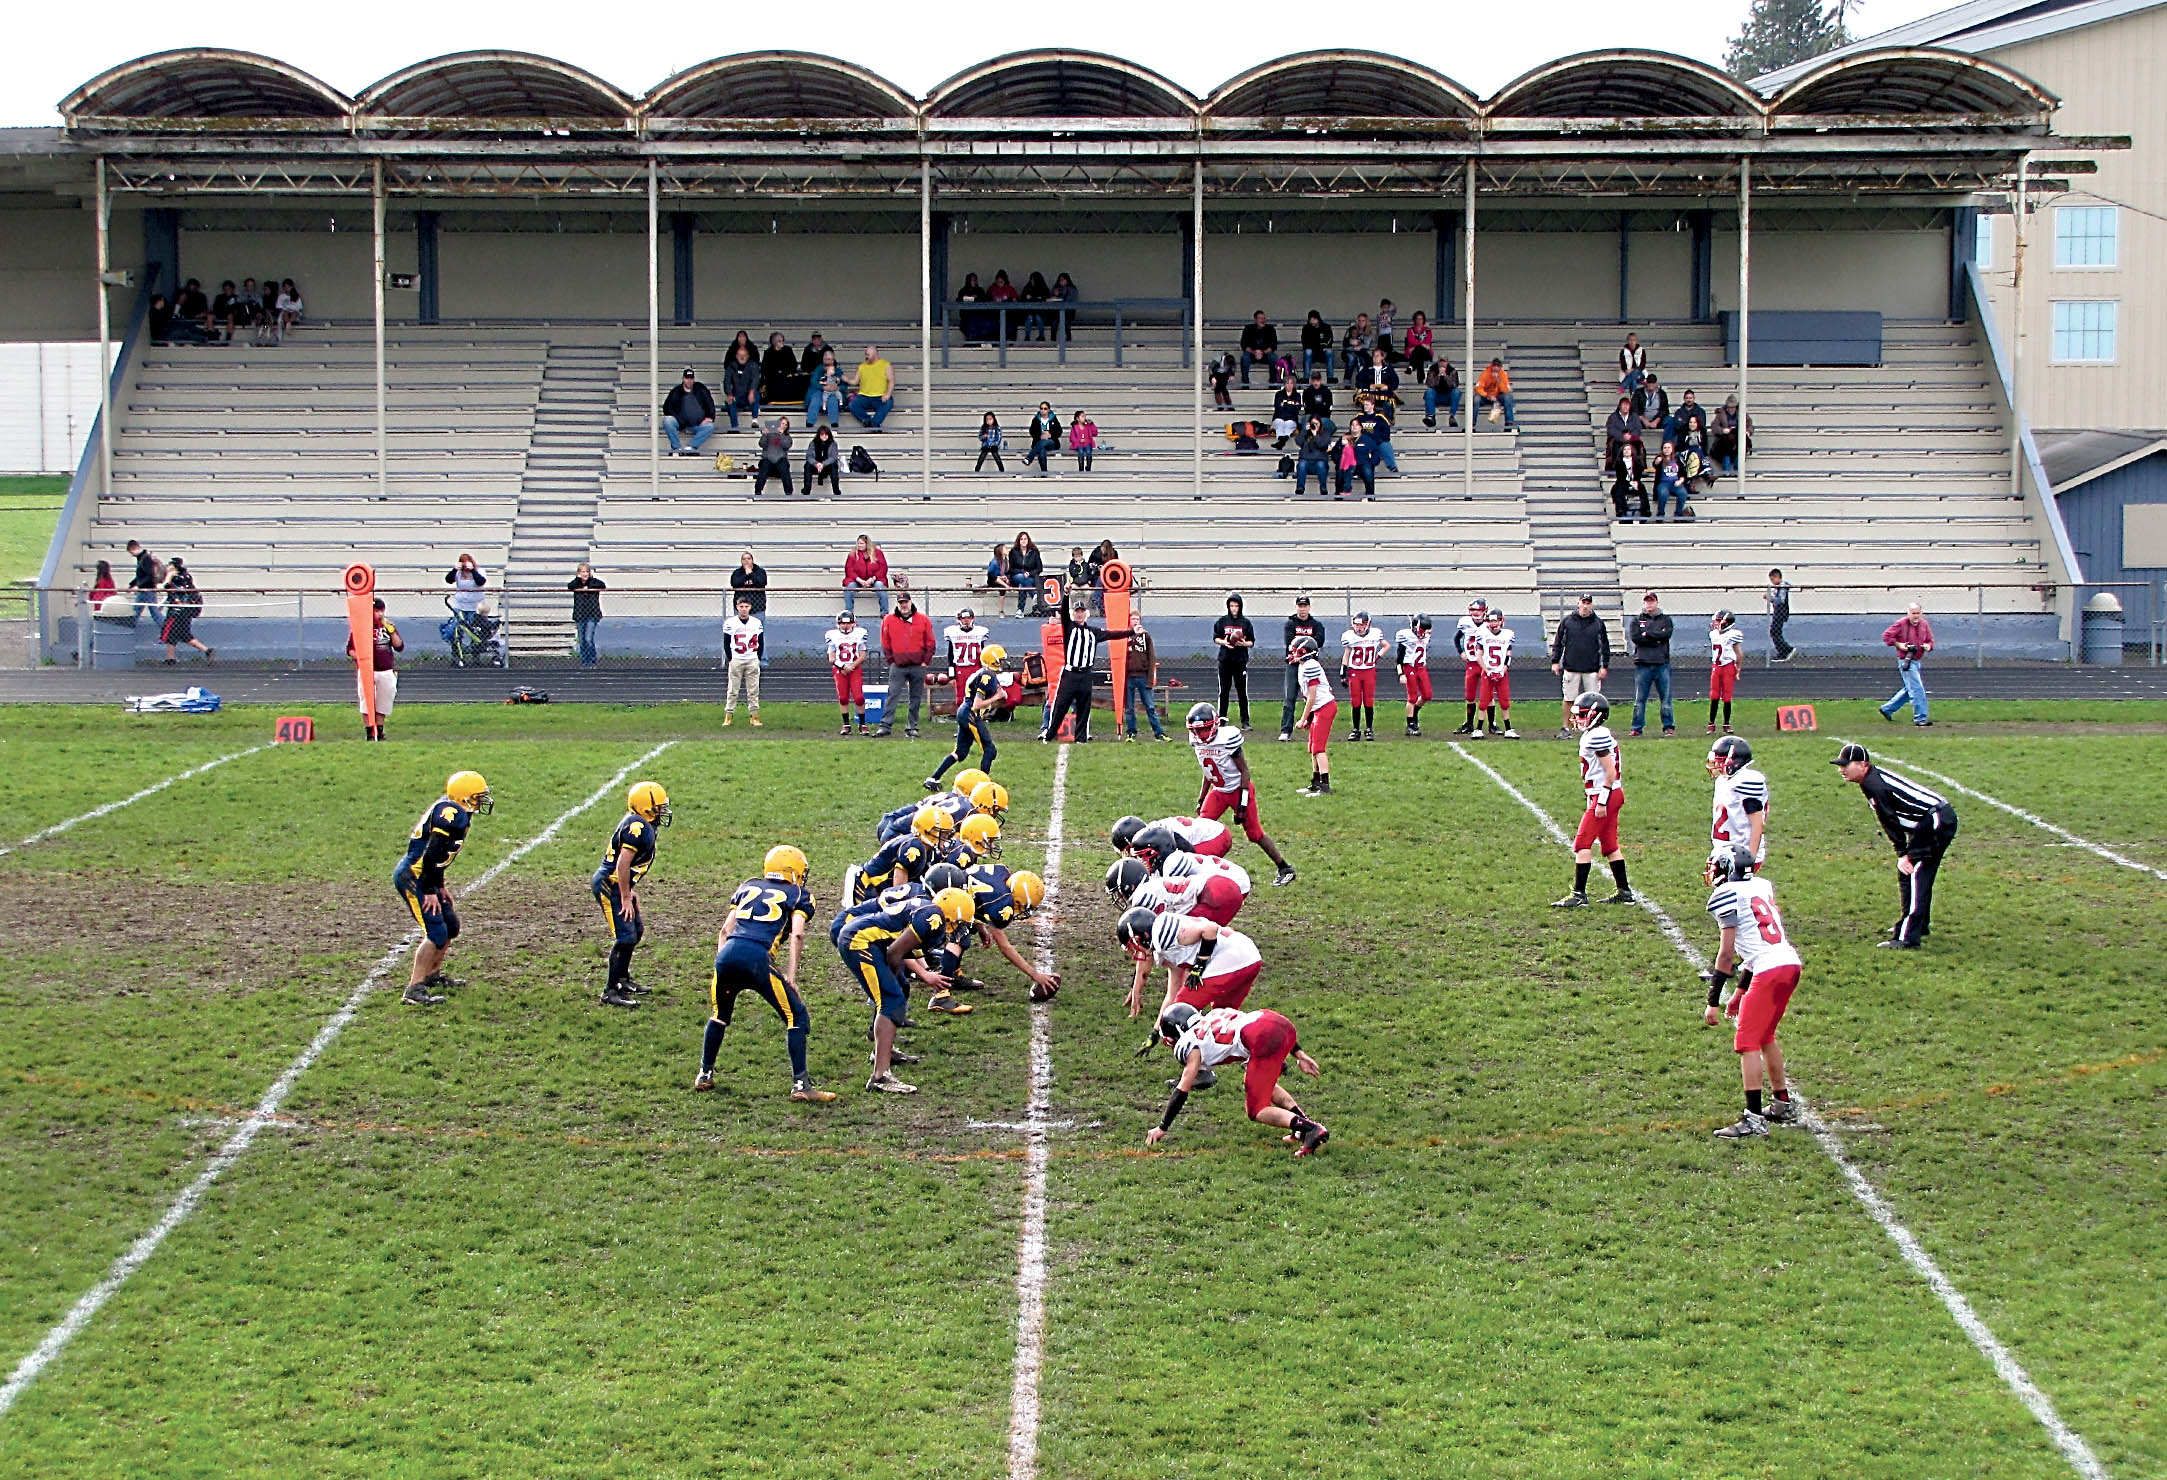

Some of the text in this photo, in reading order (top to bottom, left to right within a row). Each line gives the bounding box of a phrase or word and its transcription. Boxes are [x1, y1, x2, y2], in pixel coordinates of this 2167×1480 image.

[1043, 579, 1061, 605] 3
[734, 633, 759, 655] 54
[838, 642, 858, 662] 61
[955, 643, 981, 664] 70
[1352, 646, 1376, 667] 80
[1414, 646, 1425, 668] 2
[1488, 645, 1503, 668] 5
[1783, 708, 1813, 729] 40
[279, 720, 307, 743] 40
[1203, 757, 1225, 788] 3
[1712, 803, 1731, 842] 2
[735, 885, 788, 923] 23
[1750, 893, 1782, 945] 8
